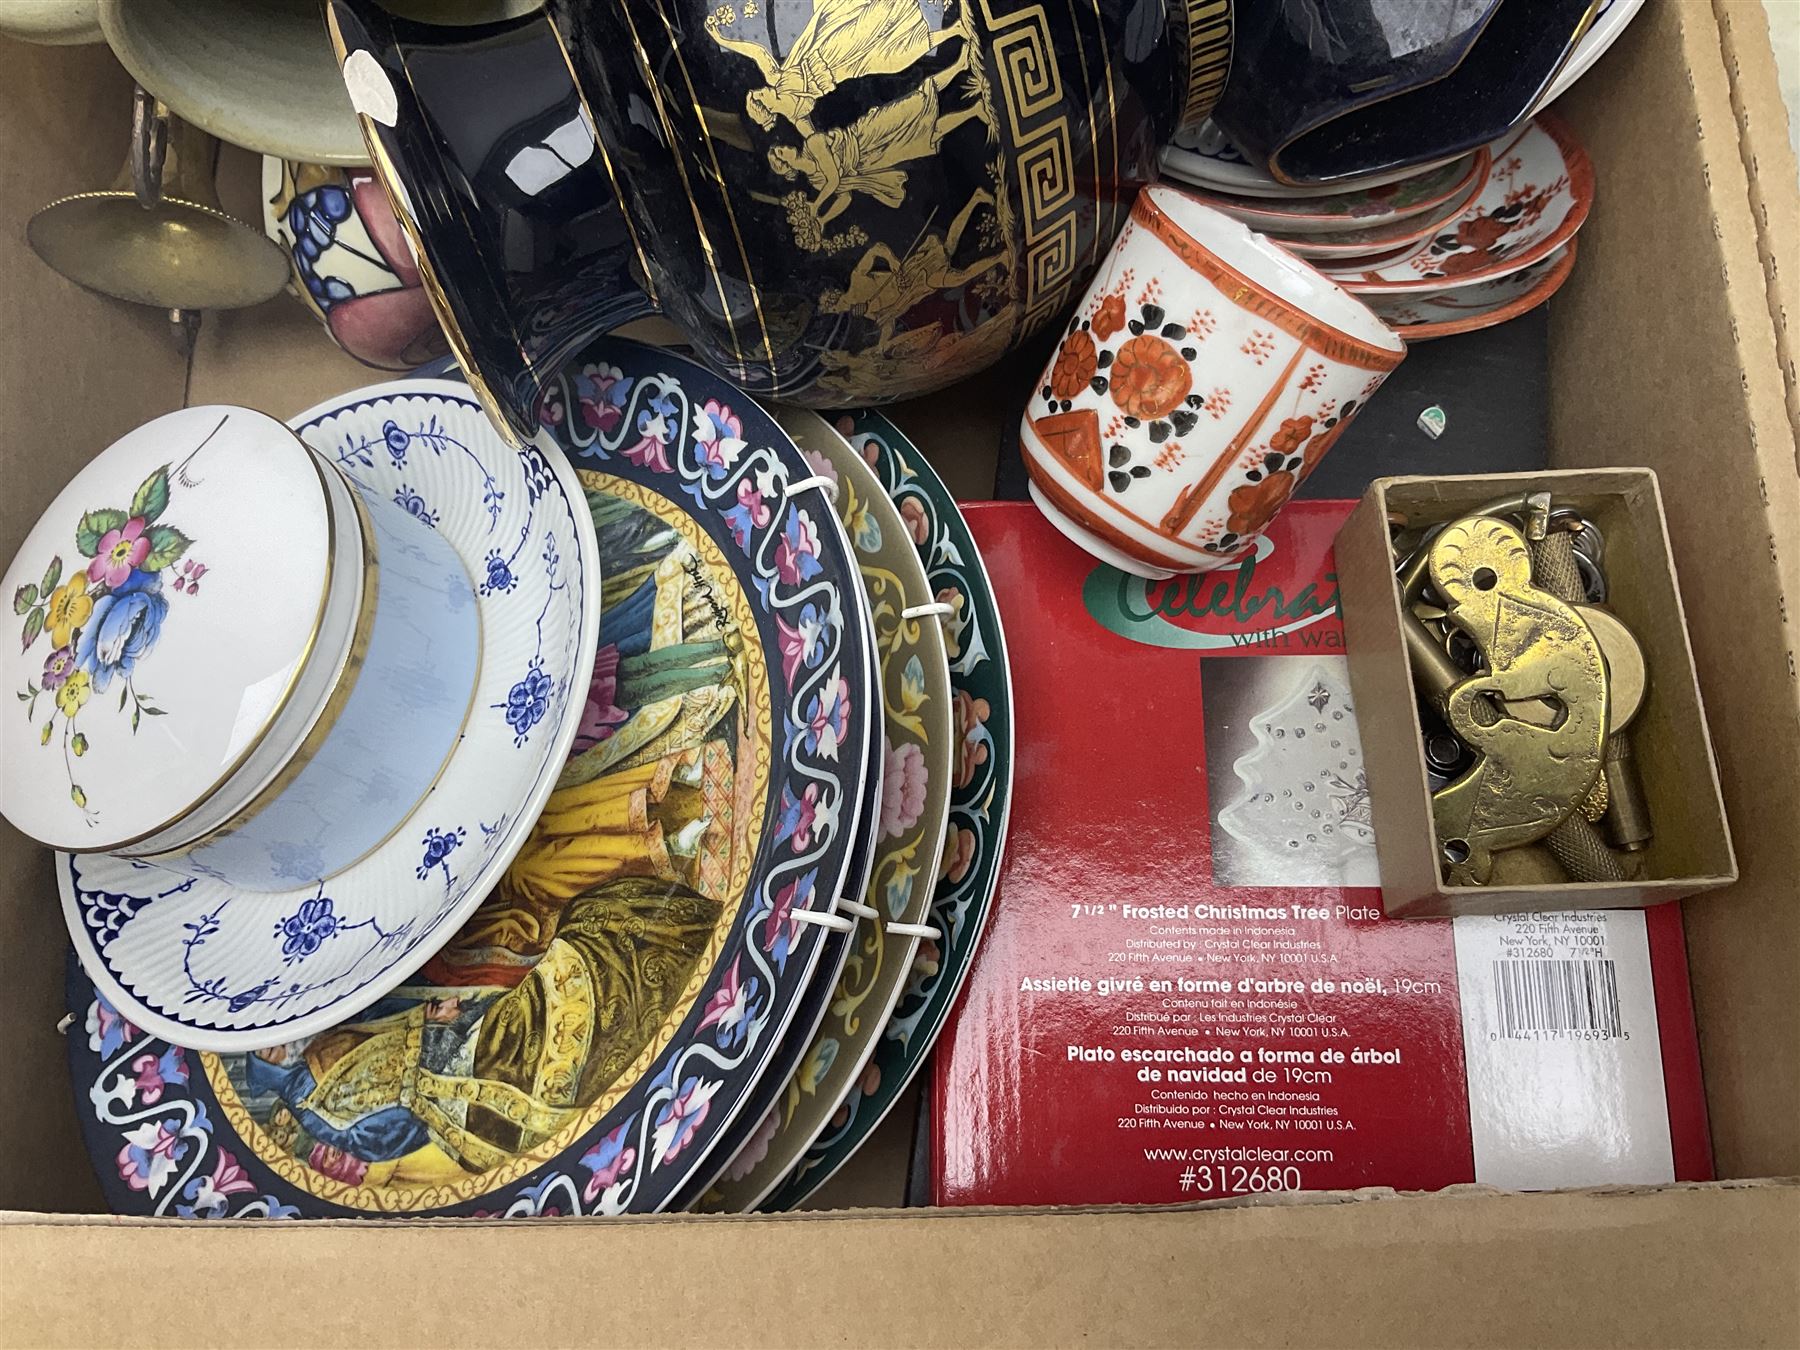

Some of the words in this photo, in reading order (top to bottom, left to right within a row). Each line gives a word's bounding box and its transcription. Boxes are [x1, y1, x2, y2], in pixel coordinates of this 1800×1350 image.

[1230, 627, 1291, 648] with
[1297, 631, 1346, 648] wa
[1122, 904, 1189, 919] Frosted
[1194, 904, 1287, 920] Christmas
[1291, 905, 1330, 920] Tree
[1335, 905, 1380, 920] Plate
[1494, 911, 1529, 924] Crystal
[1532, 911, 1557, 921] Clear
[1562, 911, 1607, 922] Industries
[1150, 926, 1197, 935] Contents
[1199, 926, 1230, 935] made
[1233, 926, 1242, 935] in
[1245, 926, 1296, 935] Indonesia
[1515, 924, 1535, 934] 220
[1539, 923, 1560, 934] Fifth
[1563, 924, 1599, 934] Avenue
[1126, 939, 1180, 948] Distributed
[1183, 939, 1196, 952] by
[1204, 939, 1239, 952] Crystal
[1243, 940, 1270, 949] Clear
[1273, 940, 1321, 949] Industries
[1500, 936, 1523, 946] New
[1526, 935, 1551, 947] York,
[1554, 936, 1570, 946] NY
[1574, 936, 1605, 946] 10001
[1107, 953, 1126, 962] 220
[1129, 953, 1150, 962] Fifth
[1152, 953, 1192, 962] Avenue
[1206, 953, 1230, 963] New
[1261, 954, 1275, 963] NY
[1280, 954, 1307, 963] 10001
[1506, 948, 1553, 958] #312680
[1020, 976, 1091, 992] Assiette
[1097, 976, 1144, 996] givré
[1149, 980, 1172, 992] en
[1177, 977, 1232, 993] forme
[1237, 978, 1305, 993] d'arbre
[1310, 978, 1335, 993] de
[1341, 977, 1388, 996] noël,
[1394, 979, 1441, 994] 19cm
[1162, 999, 1208, 1008] Contenu
[1211, 999, 1228, 1008] fait
[1231, 1001, 1244, 1009] en
[1247, 999, 1297, 1009] Indonésie
[1126, 1012, 1170, 1022] Distribué
[1173, 1014, 1190, 1024] par
[1200, 1013, 1216, 1022] Les
[1218, 1013, 1266, 1023] Industries
[1269, 1013, 1305, 1025] Crystal
[1307, 1013, 1335, 1023] Clear
[1113, 1026, 1131, 1036] 220
[1134, 1026, 1154, 1036] Fifth
[1158, 1026, 1198, 1036] Avenue
[1216, 1027, 1240, 1036] New
[1271, 1027, 1286, 1036] NY
[1290, 1027, 1318, 1037] 10001
[1322, 1027, 1351, 1037] U.S.A.
[1490, 1033, 1497, 1041] 0
[1514, 1030, 1558, 1040] 44117
[1567, 1030, 1609, 1040] 19693
[1624, 1031, 1630, 1040] 5
[1067, 1046, 1115, 1062] Plato
[1120, 1047, 1234, 1063] escarchado
[1240, 1050, 1252, 1063] a
[1258, 1047, 1315, 1063] forma
[1320, 1048, 1345, 1064] de
[1351, 1046, 1400, 1064] árbol
[1137, 1066, 1162, 1082] de
[1167, 1066, 1247, 1083] navidad
[1252, 1068, 1277, 1083] de
[1284, 1068, 1332, 1083] 19cm
[1151, 1090, 1208, 1100] Contenido
[1213, 1090, 1248, 1100] hecho
[1251, 1093, 1265, 1101] en
[1268, 1091, 1320, 1101] Indonesia
[1135, 1104, 1189, 1114] Distribuido
[1192, 1106, 1210, 1116] por
[1219, 1105, 1255, 1116] Crystal
[1258, 1105, 1286, 1115] Clear
[1289, 1105, 1338, 1116] Industries
[1118, 1118, 1136, 1128] 220
[1139, 1118, 1160, 1128] Fifth
[1163, 1118, 1205, 1129] Avenue
[1219, 1119, 1244, 1129] New
[1276, 1120, 1290, 1129] NY
[1294, 1120, 1323, 1130] 10001
[1327, 1120, 1356, 1130] U.S.A.
[1144, 1146, 1334, 1163] www.crystalclear.com
[1179, 1166, 1301, 1192] #312680
